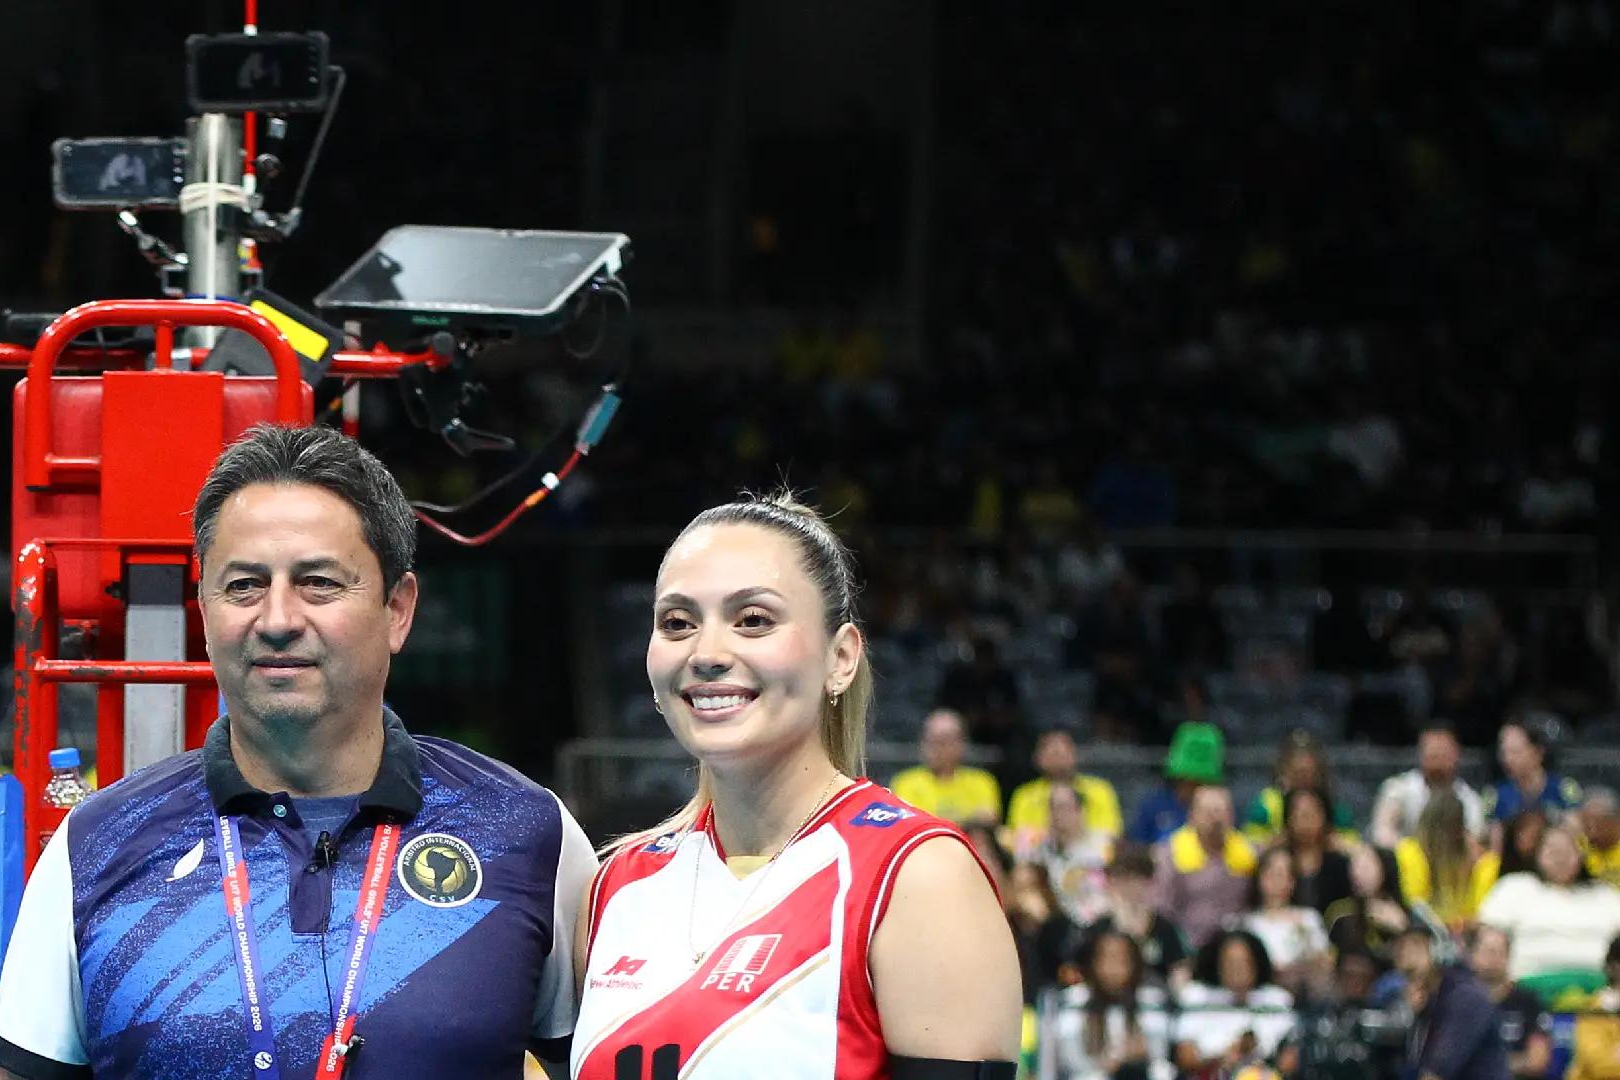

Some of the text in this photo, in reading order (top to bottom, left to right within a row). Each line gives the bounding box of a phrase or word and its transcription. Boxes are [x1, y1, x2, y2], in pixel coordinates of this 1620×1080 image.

[370, 836, 390, 888] VOLLEYBALL
[233, 897, 246, 930] WORLD
[238, 931, 258, 1005] CHAMPIONSHIP
[350, 935, 366, 968] WORLD
[700, 973, 755, 993] PER
[250, 1006, 263, 1031] 2026
[334, 968, 357, 1045] CHAMPIONSHIP
